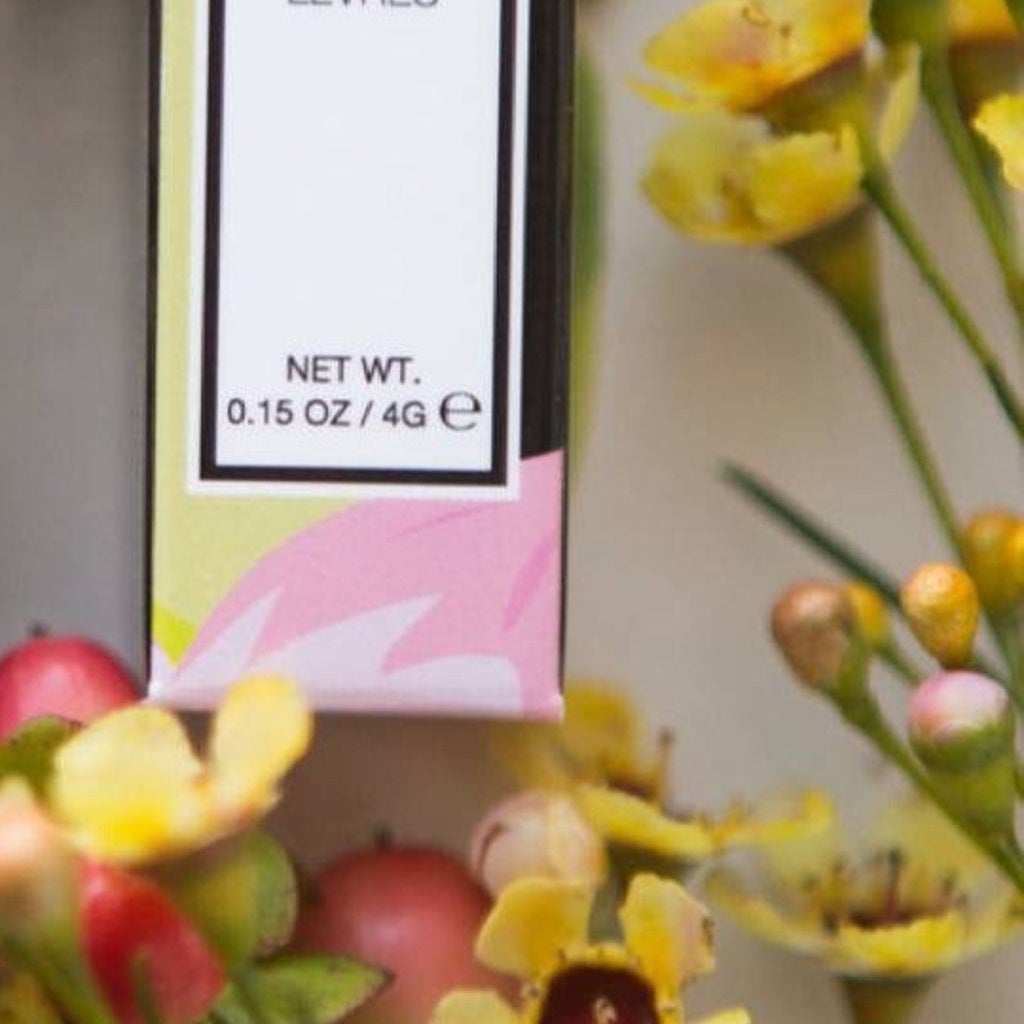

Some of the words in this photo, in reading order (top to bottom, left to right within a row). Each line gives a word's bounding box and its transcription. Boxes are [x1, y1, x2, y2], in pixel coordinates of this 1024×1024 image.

[287, 355, 350, 383] NET
[362, 356, 421, 384] WT.
[227, 399, 293, 426] 0.15
[305, 400, 351, 426] OZ
[360, 401, 373, 427] /
[382, 400, 426, 427] 4G
